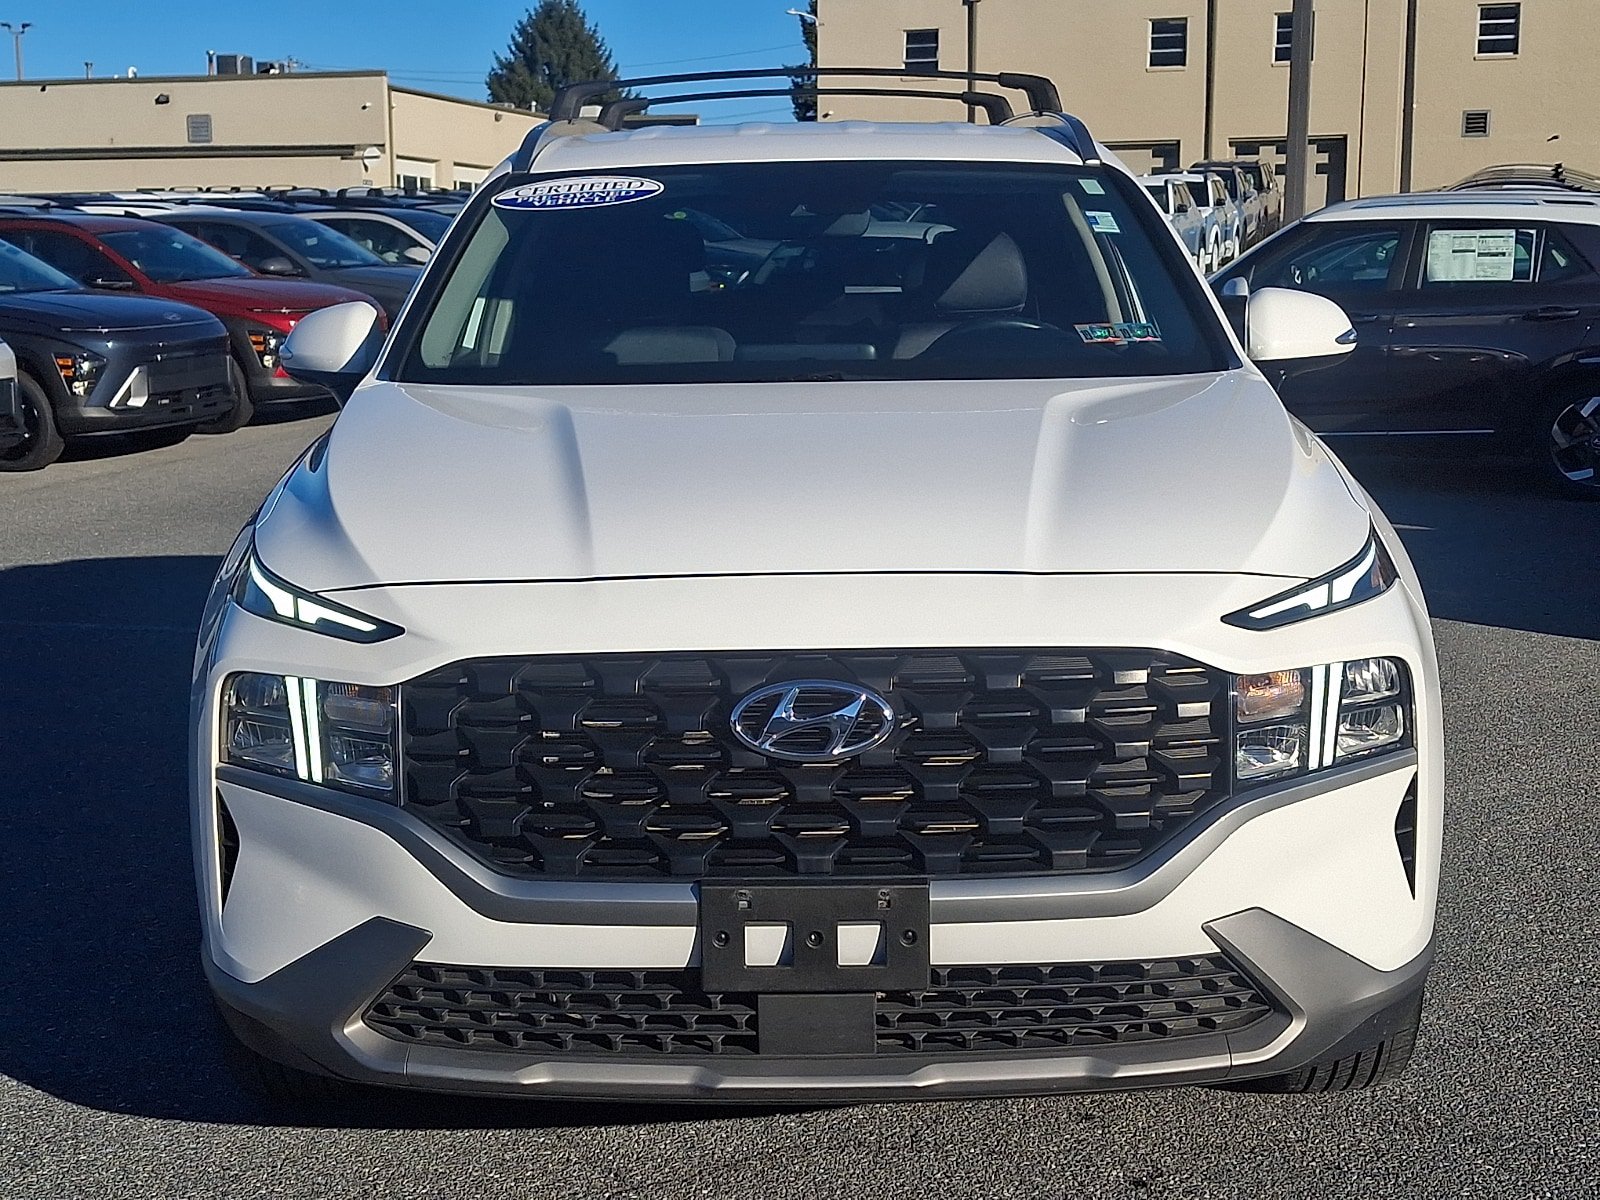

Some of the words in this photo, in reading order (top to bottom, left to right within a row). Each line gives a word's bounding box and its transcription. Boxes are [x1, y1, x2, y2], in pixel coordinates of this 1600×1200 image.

[514, 181, 645, 197] CERTIFIED
[516, 190, 636, 204] PRE-OWNED
[532, 195, 616, 207] VEHICLE
